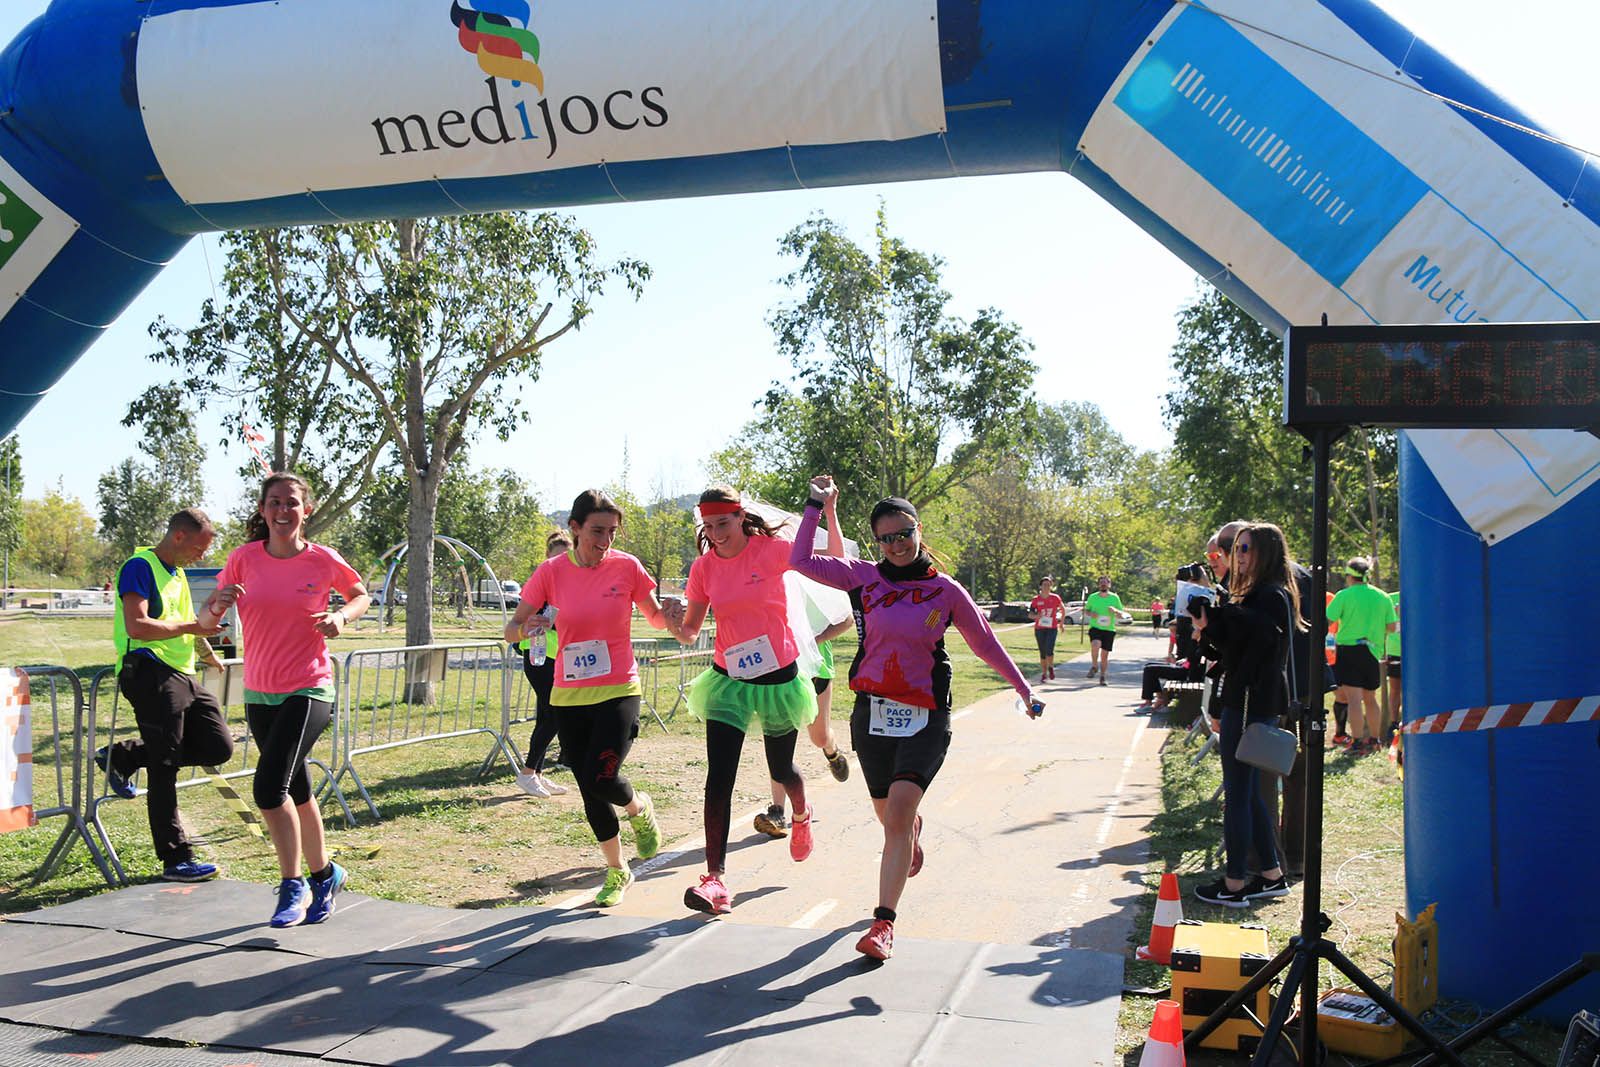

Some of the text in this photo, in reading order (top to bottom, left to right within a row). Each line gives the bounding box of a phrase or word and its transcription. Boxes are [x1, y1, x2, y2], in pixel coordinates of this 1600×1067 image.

[371, 76, 668, 159] medijocs
[1403, 254, 1489, 323] Mutu
[573, 653, 597, 668] 419
[738, 651, 763, 669] 418
[886, 707, 913, 716] PACO
[886, 717, 912, 729] 337
